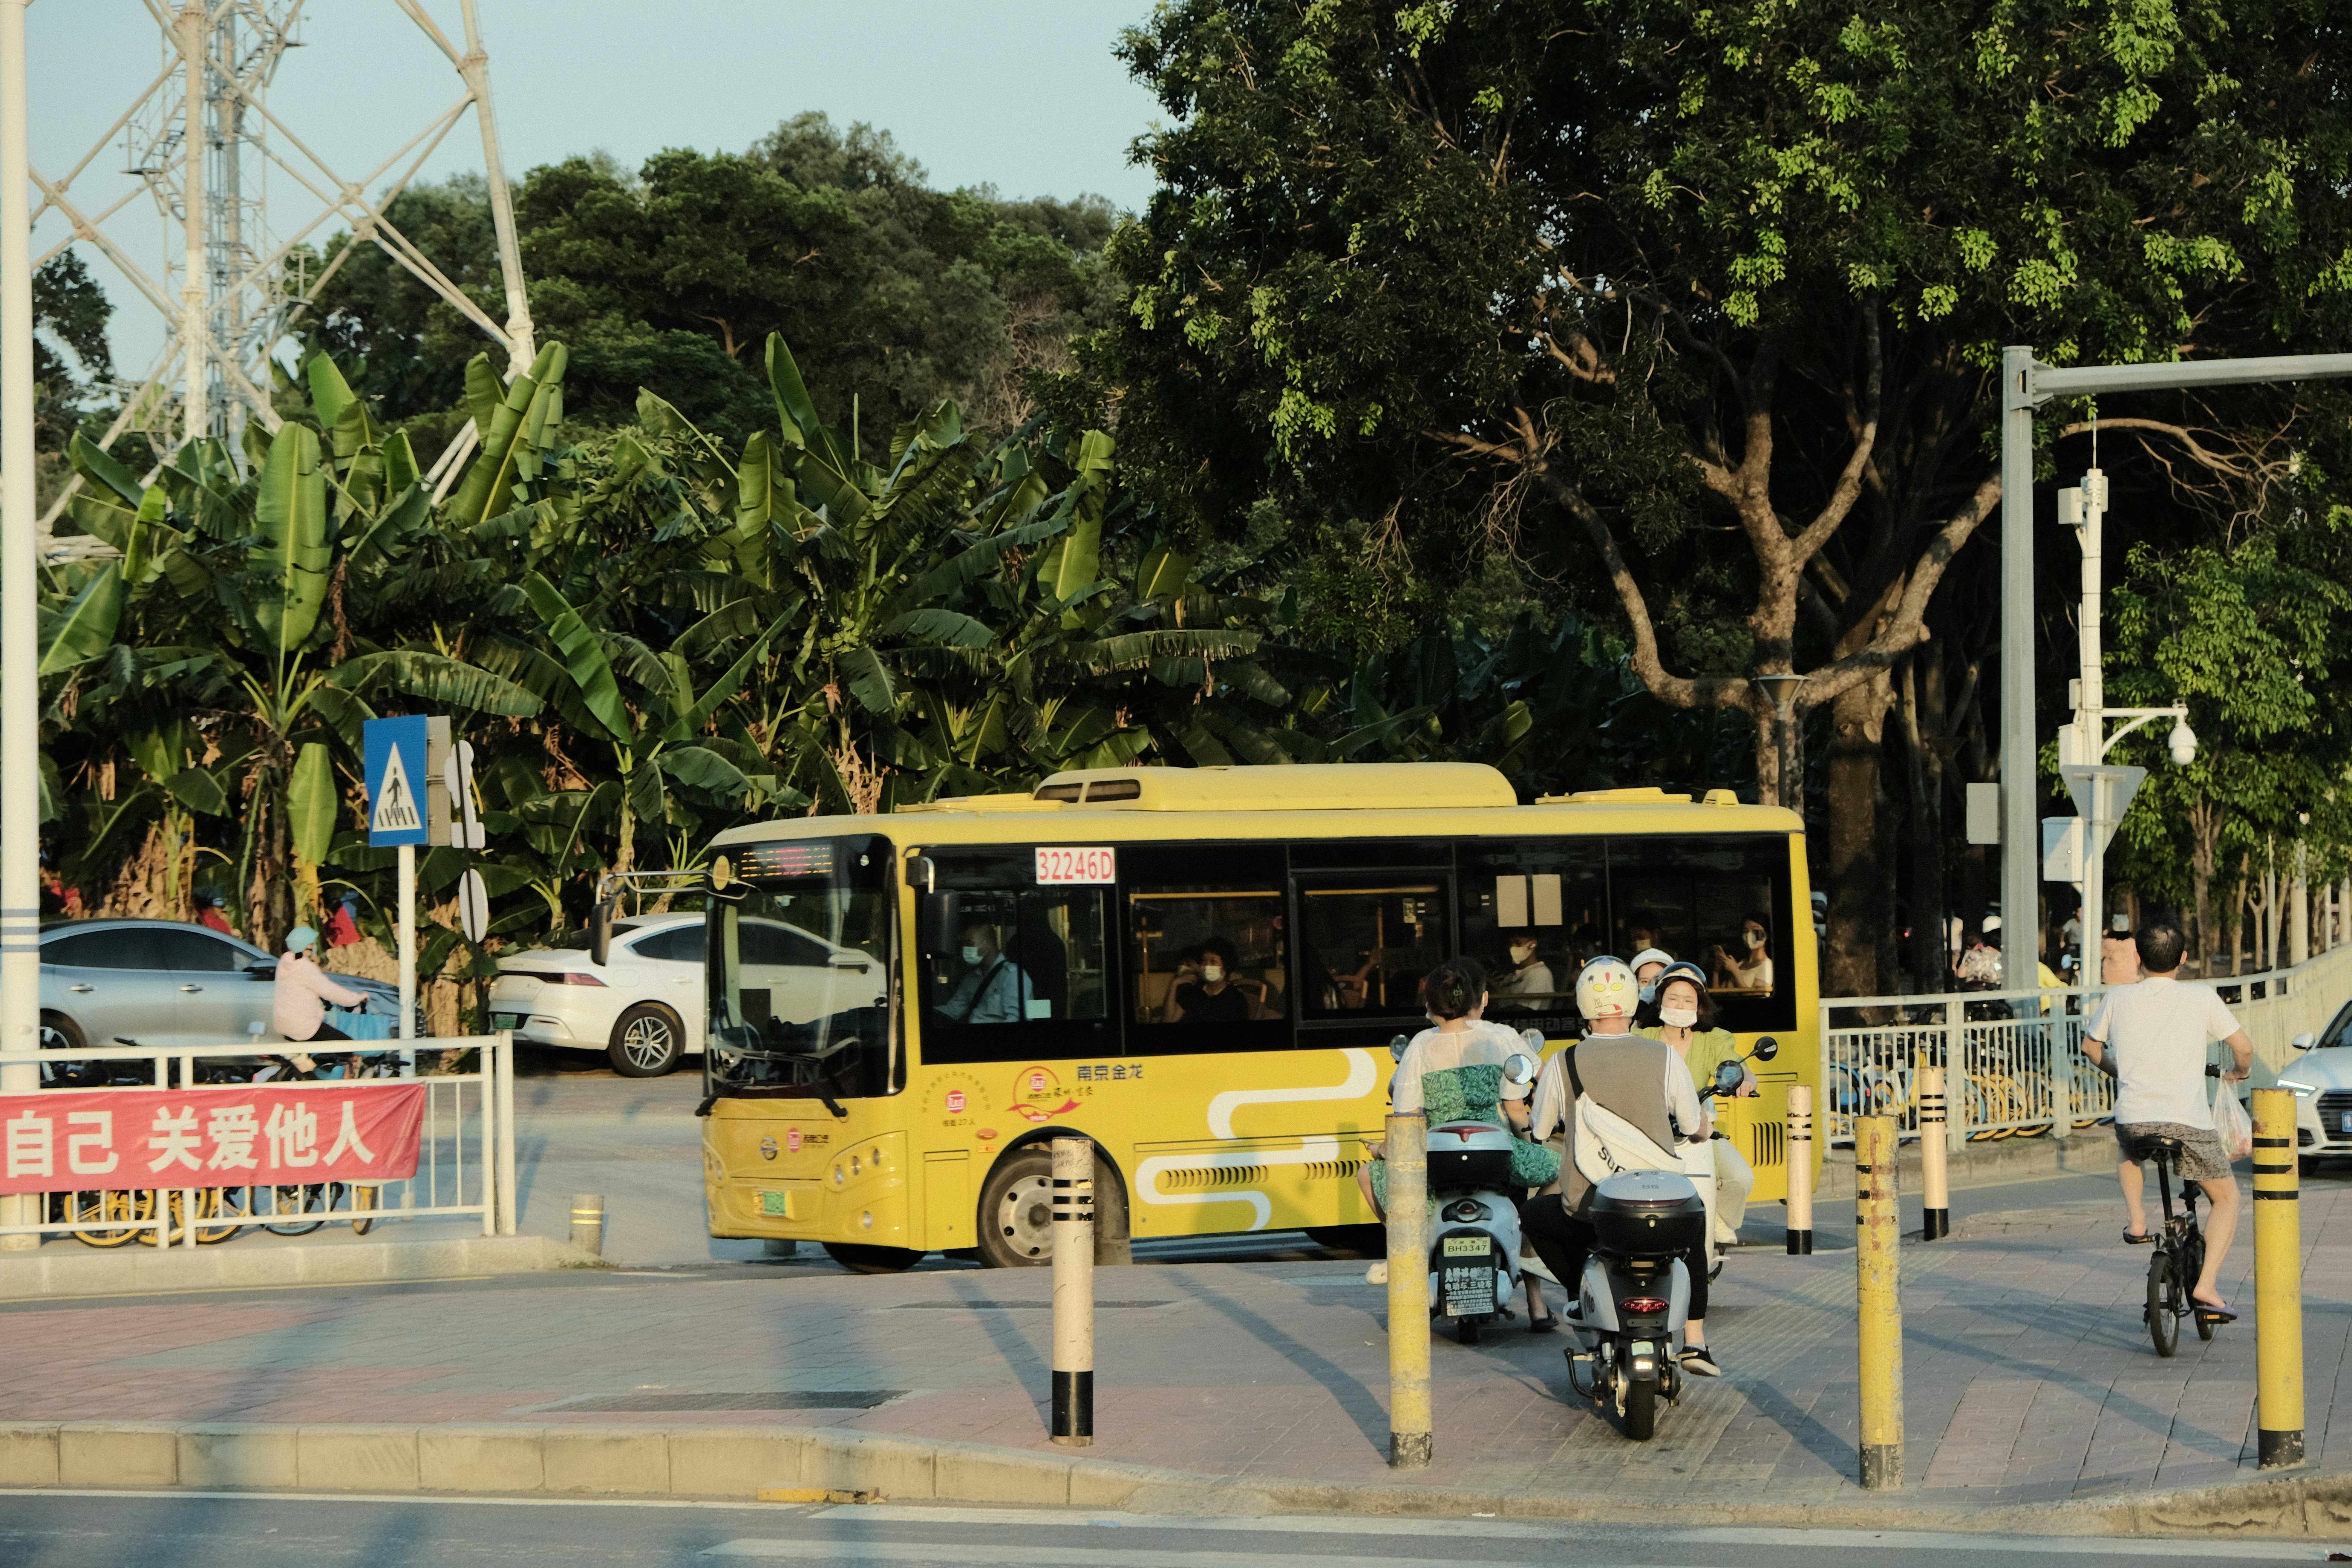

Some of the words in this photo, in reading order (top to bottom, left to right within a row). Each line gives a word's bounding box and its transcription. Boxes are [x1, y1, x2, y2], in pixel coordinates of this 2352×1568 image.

[1038, 851, 1113, 880] 32246D
[1077, 1064, 1142, 1081] 南京金龙
[6, 1110, 119, 1179] 自己
[147, 1100, 375, 1173] 关爱他人
